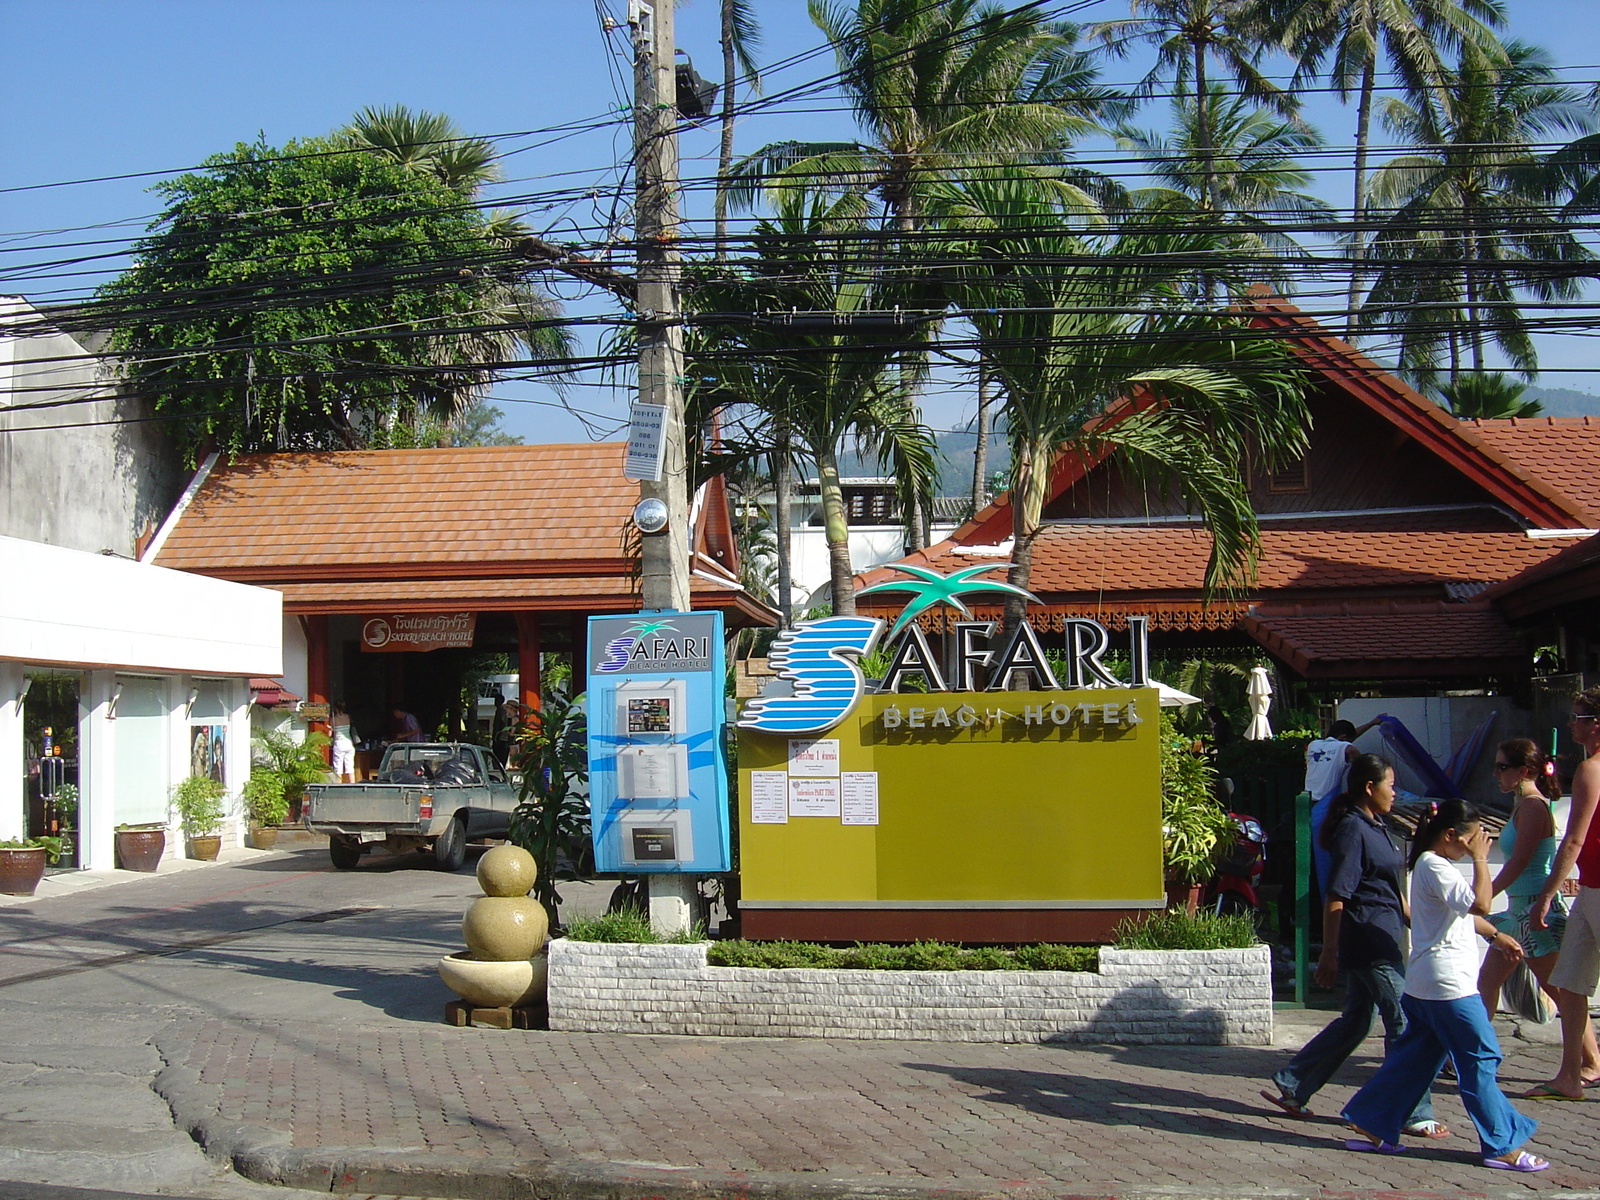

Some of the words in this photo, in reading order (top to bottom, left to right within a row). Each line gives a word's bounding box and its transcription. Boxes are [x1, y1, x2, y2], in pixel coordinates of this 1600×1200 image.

[420, 632, 446, 642] BEACH
[447, 630, 473, 640] HOTEL
[595, 636, 708, 672] SAFARI
[629, 661, 666, 670] BEACH
[672, 660, 708, 669] HOTEL
[736, 615, 1150, 734] SAFARI
[883, 704, 1002, 730] BEACH
[1024, 701, 1144, 726] HOTEL
